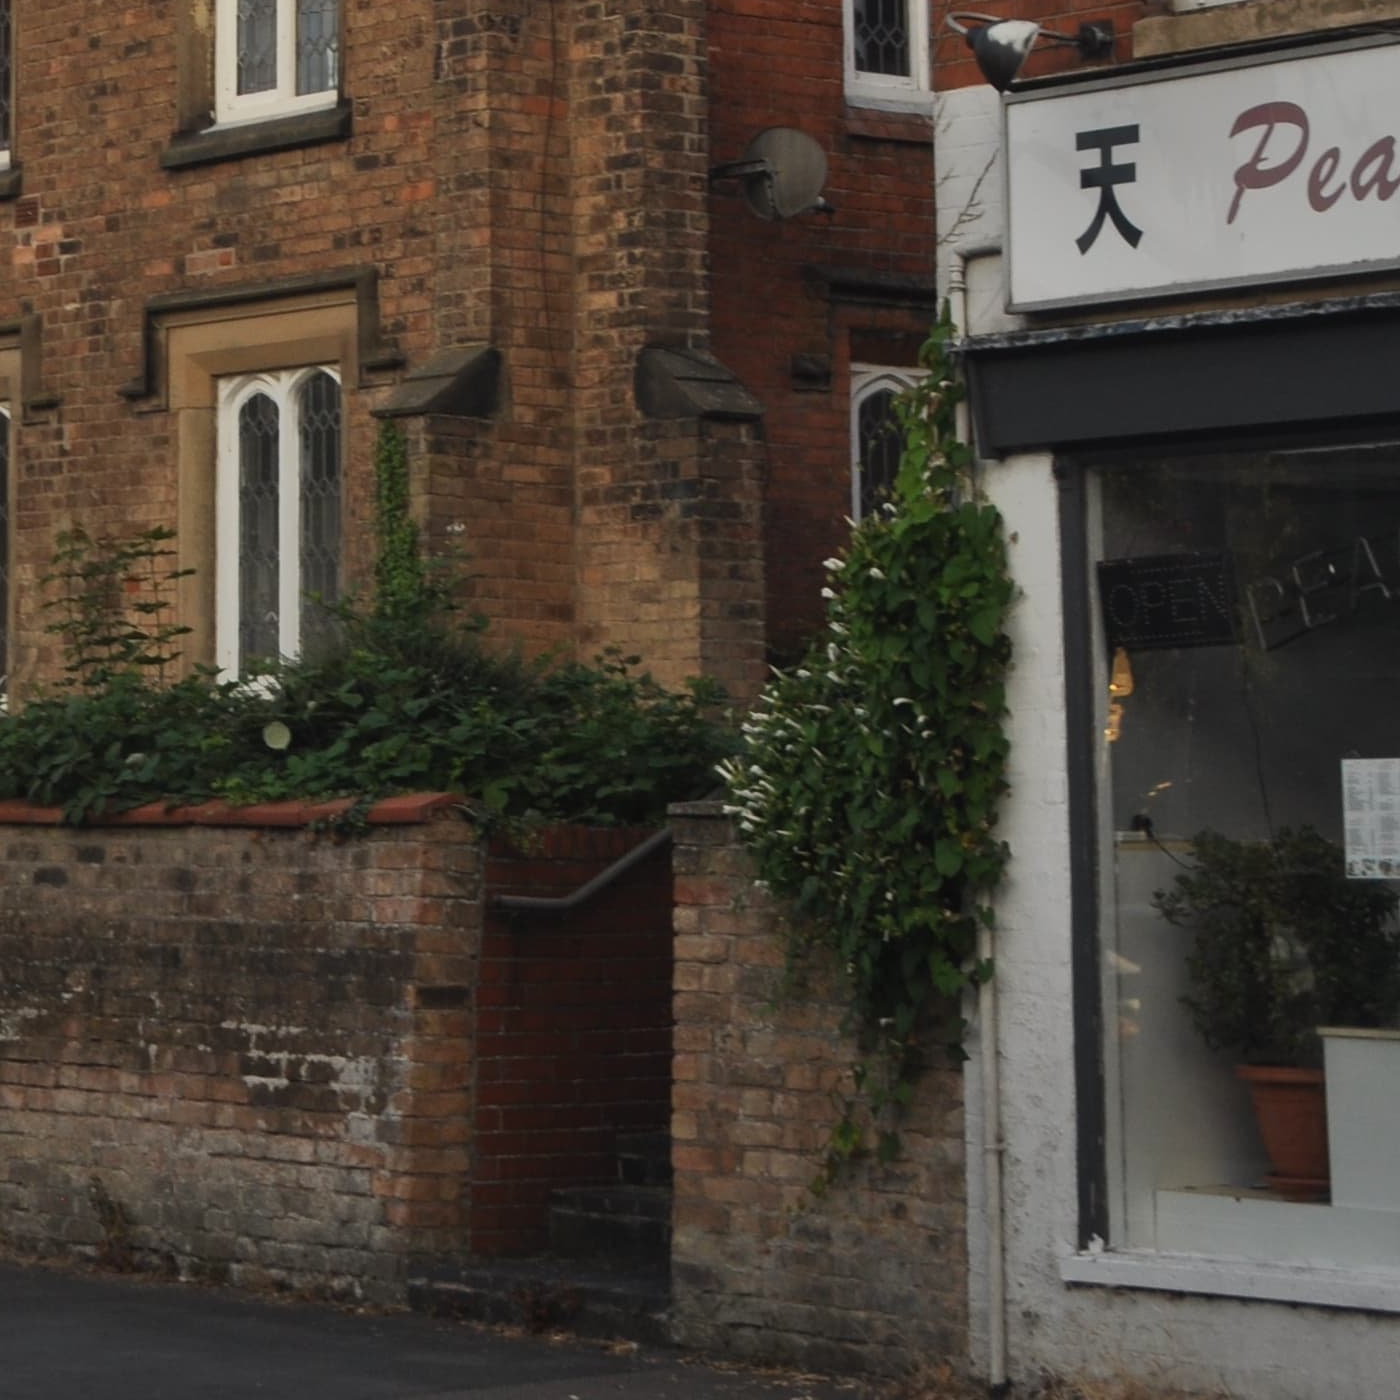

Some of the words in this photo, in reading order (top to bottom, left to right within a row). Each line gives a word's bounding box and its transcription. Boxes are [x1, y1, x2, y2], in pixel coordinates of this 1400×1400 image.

[1075, 124, 1143, 255] 天
[1227, 101, 1400, 225] Pea
[1108, 574, 1229, 626] OPEN
